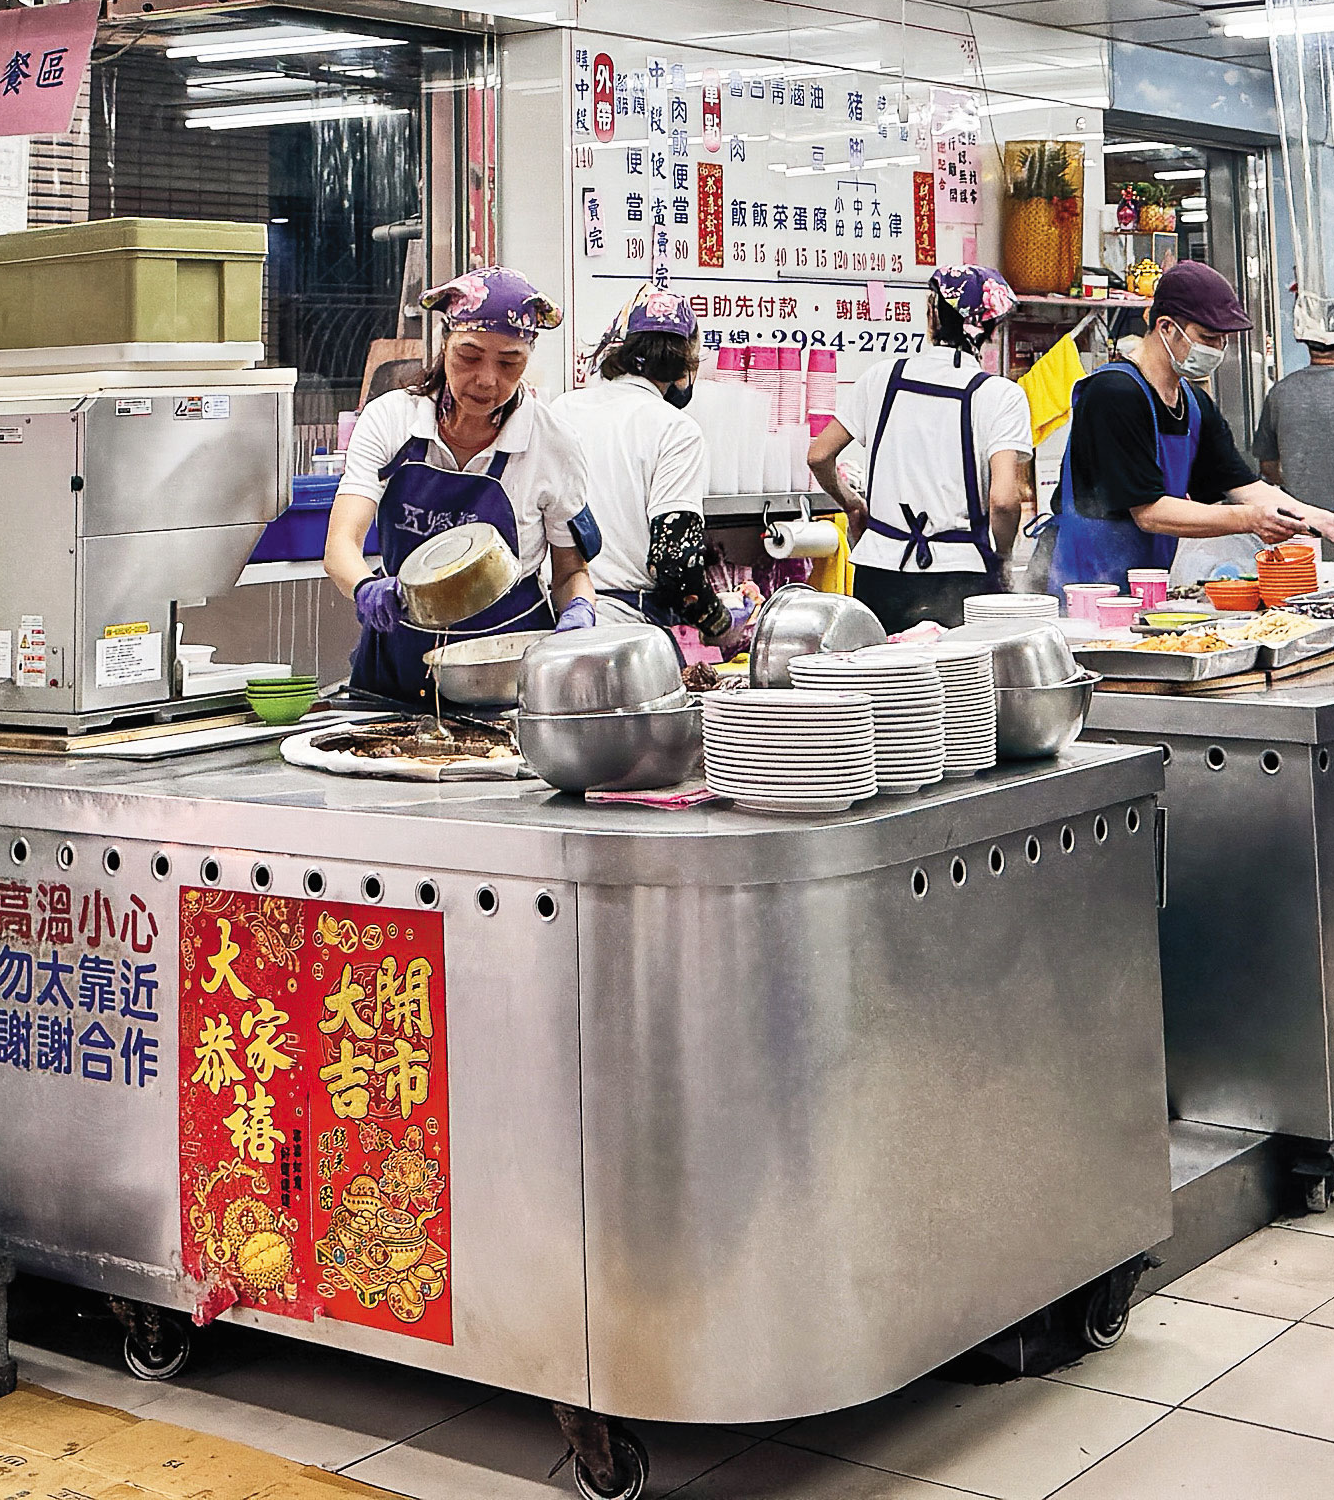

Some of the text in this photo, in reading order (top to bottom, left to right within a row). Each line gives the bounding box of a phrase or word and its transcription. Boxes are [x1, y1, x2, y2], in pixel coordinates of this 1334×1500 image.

[595, 65, 613, 131] 外帶
[575, 147, 593, 168] 140
[588, 197, 604, 250] 賣完
[626, 238, 644, 259] 130
[675, 240, 689, 260] 80
[733, 242, 746, 261] 35
[754, 243, 766, 263] 15
[774, 247, 787, 266] 40
[796, 247, 807, 267] 15
[815, 249, 827, 268] 15
[834, 250, 848, 270] 120
[852, 252, 867, 271] 180
[870, 252, 886, 272] 240
[891, 254, 903, 273] 25
